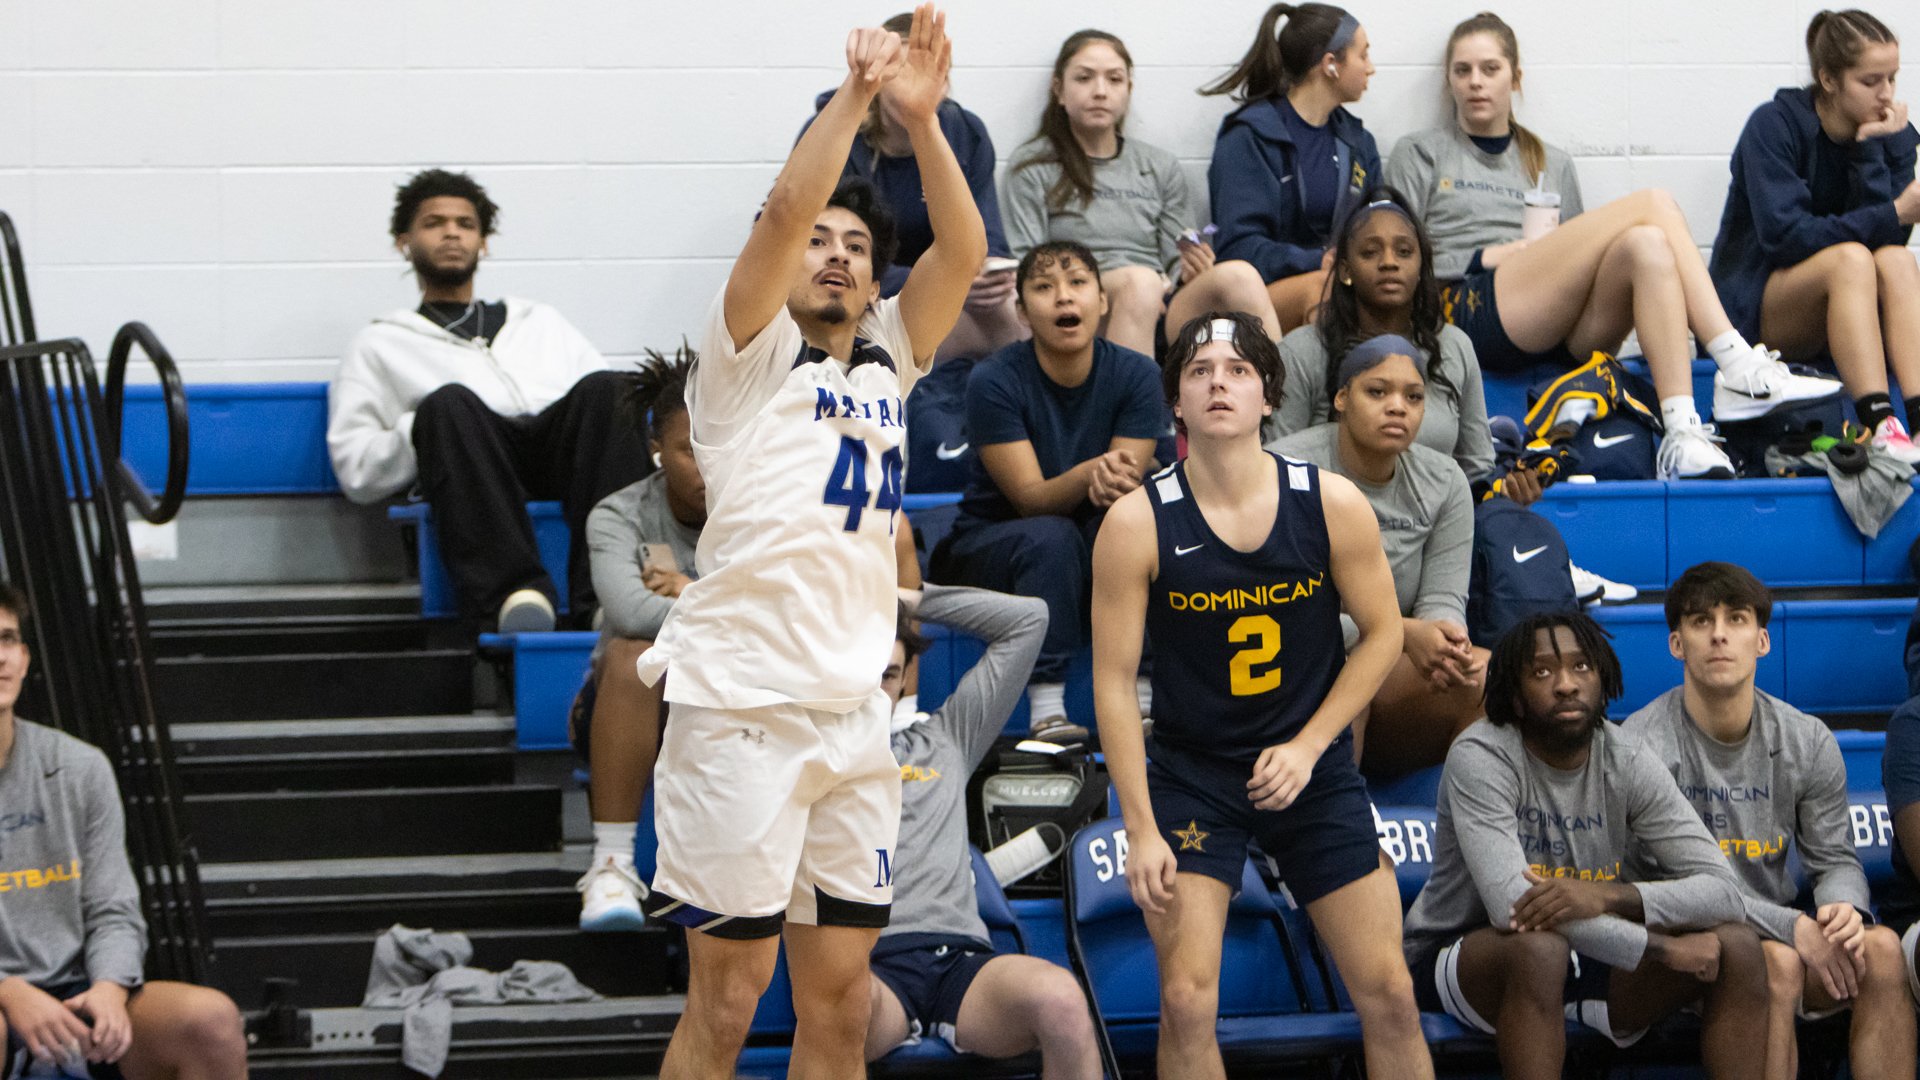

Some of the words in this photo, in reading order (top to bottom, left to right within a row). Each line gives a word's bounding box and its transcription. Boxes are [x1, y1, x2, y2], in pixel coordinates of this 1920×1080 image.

[1453, 179, 1525, 200] BASKETB
[813, 386, 905, 429] MAIA
[822, 434, 904, 536] 44
[1168, 571, 1324, 612] DOMINICAN
[1227, 614, 1282, 697] 2
[998, 785, 1070, 797] MUELLER
[1680, 784, 1770, 802] OMNICAN
[1381, 819, 1437, 864] BR
[1518, 833, 1566, 857] TARS
[1848, 804, 1895, 848] BR
[0, 860, 82, 892] ETBALL
[1088, 829, 1130, 883] SA
